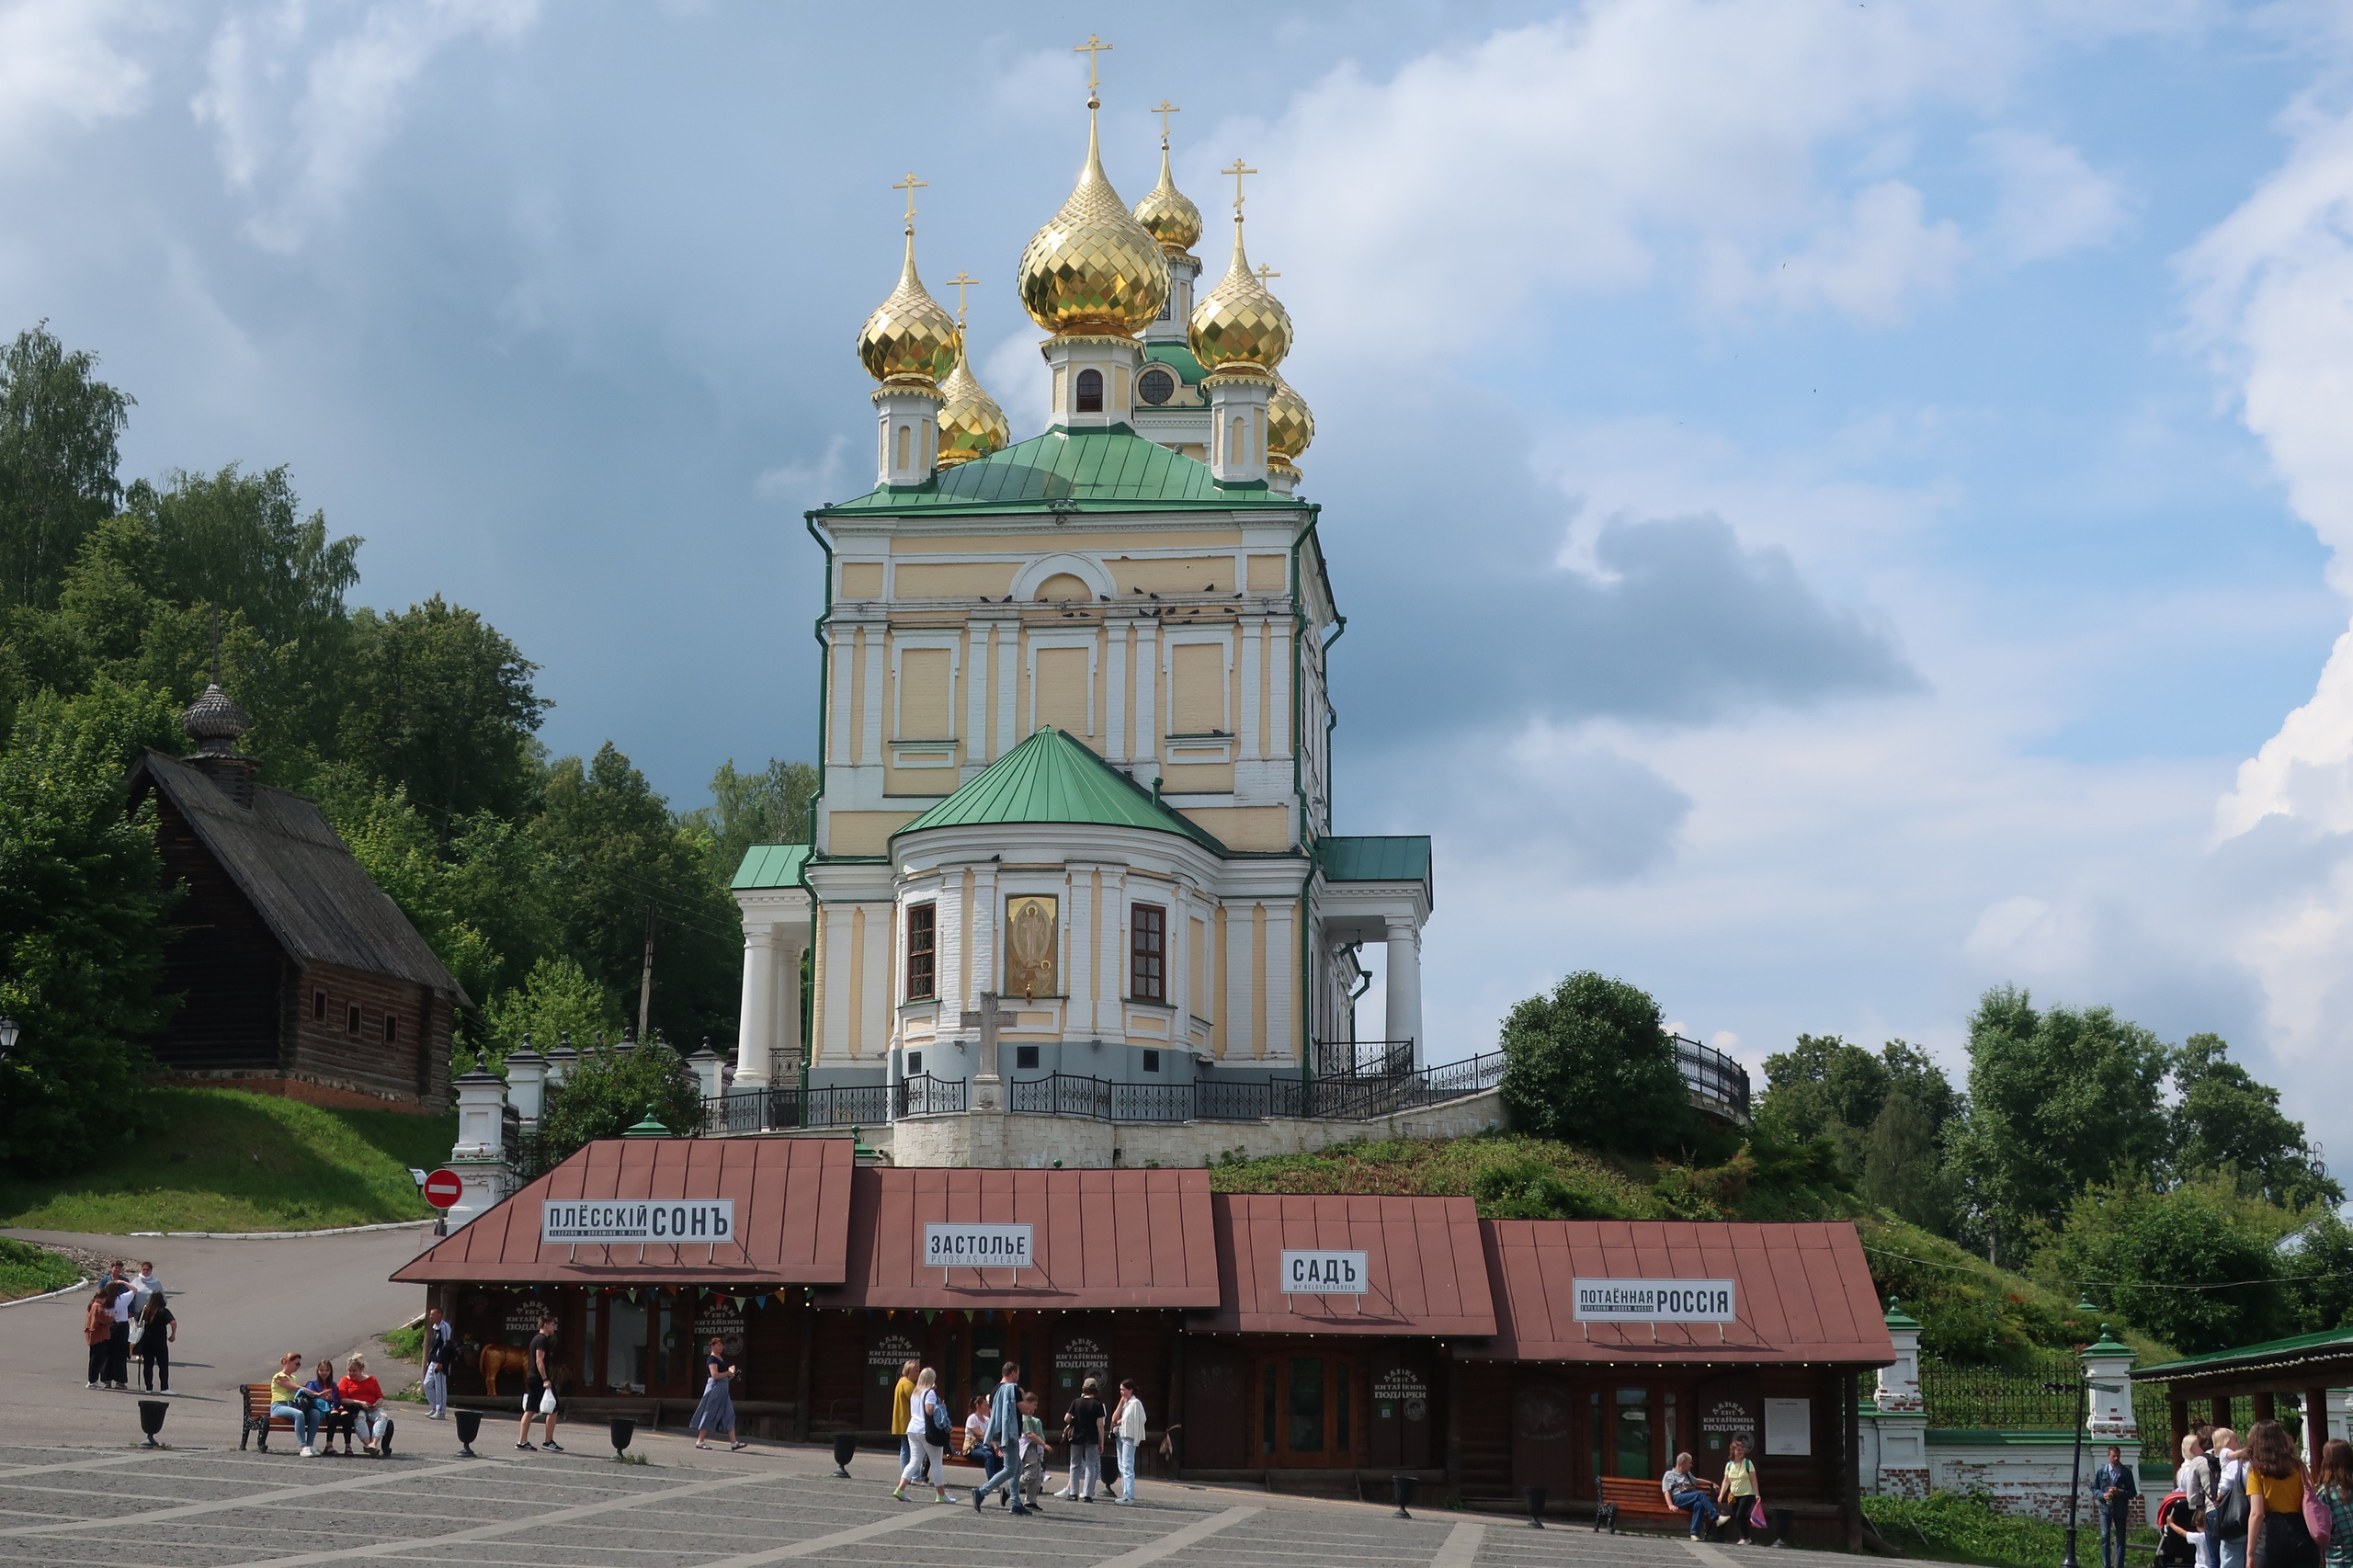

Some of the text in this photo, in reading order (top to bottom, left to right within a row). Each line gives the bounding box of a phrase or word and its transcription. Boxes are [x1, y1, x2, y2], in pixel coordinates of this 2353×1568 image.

[652, 1207, 728, 1236] СОНЪ
[931, 1235, 1025, 1255] ЗАСТОЛЬЕ
[931, 1255, 1025, 1265] PLIOS AS A FEAST
[1293, 1259, 1356, 1284] САДЪ
[1580, 1288, 1654, 1304] ПОТАЁННАЯ
[516, 1301, 550, 1314] ЛАВКИ
[694, 1326, 745, 1335] ПОДАРКИ
[879, 1335, 913, 1349] ЛАВКИ
[1064, 1338, 1099, 1352] ЛАВКИ
[1383, 1369, 1418, 1383] ЛАВКИ
[1374, 1392, 1427, 1400] ПОДАРКИ
[1711, 1402, 1746, 1415] ЛАВКИ
[1703, 1424, 1755, 1432] ПОДАРКИ
